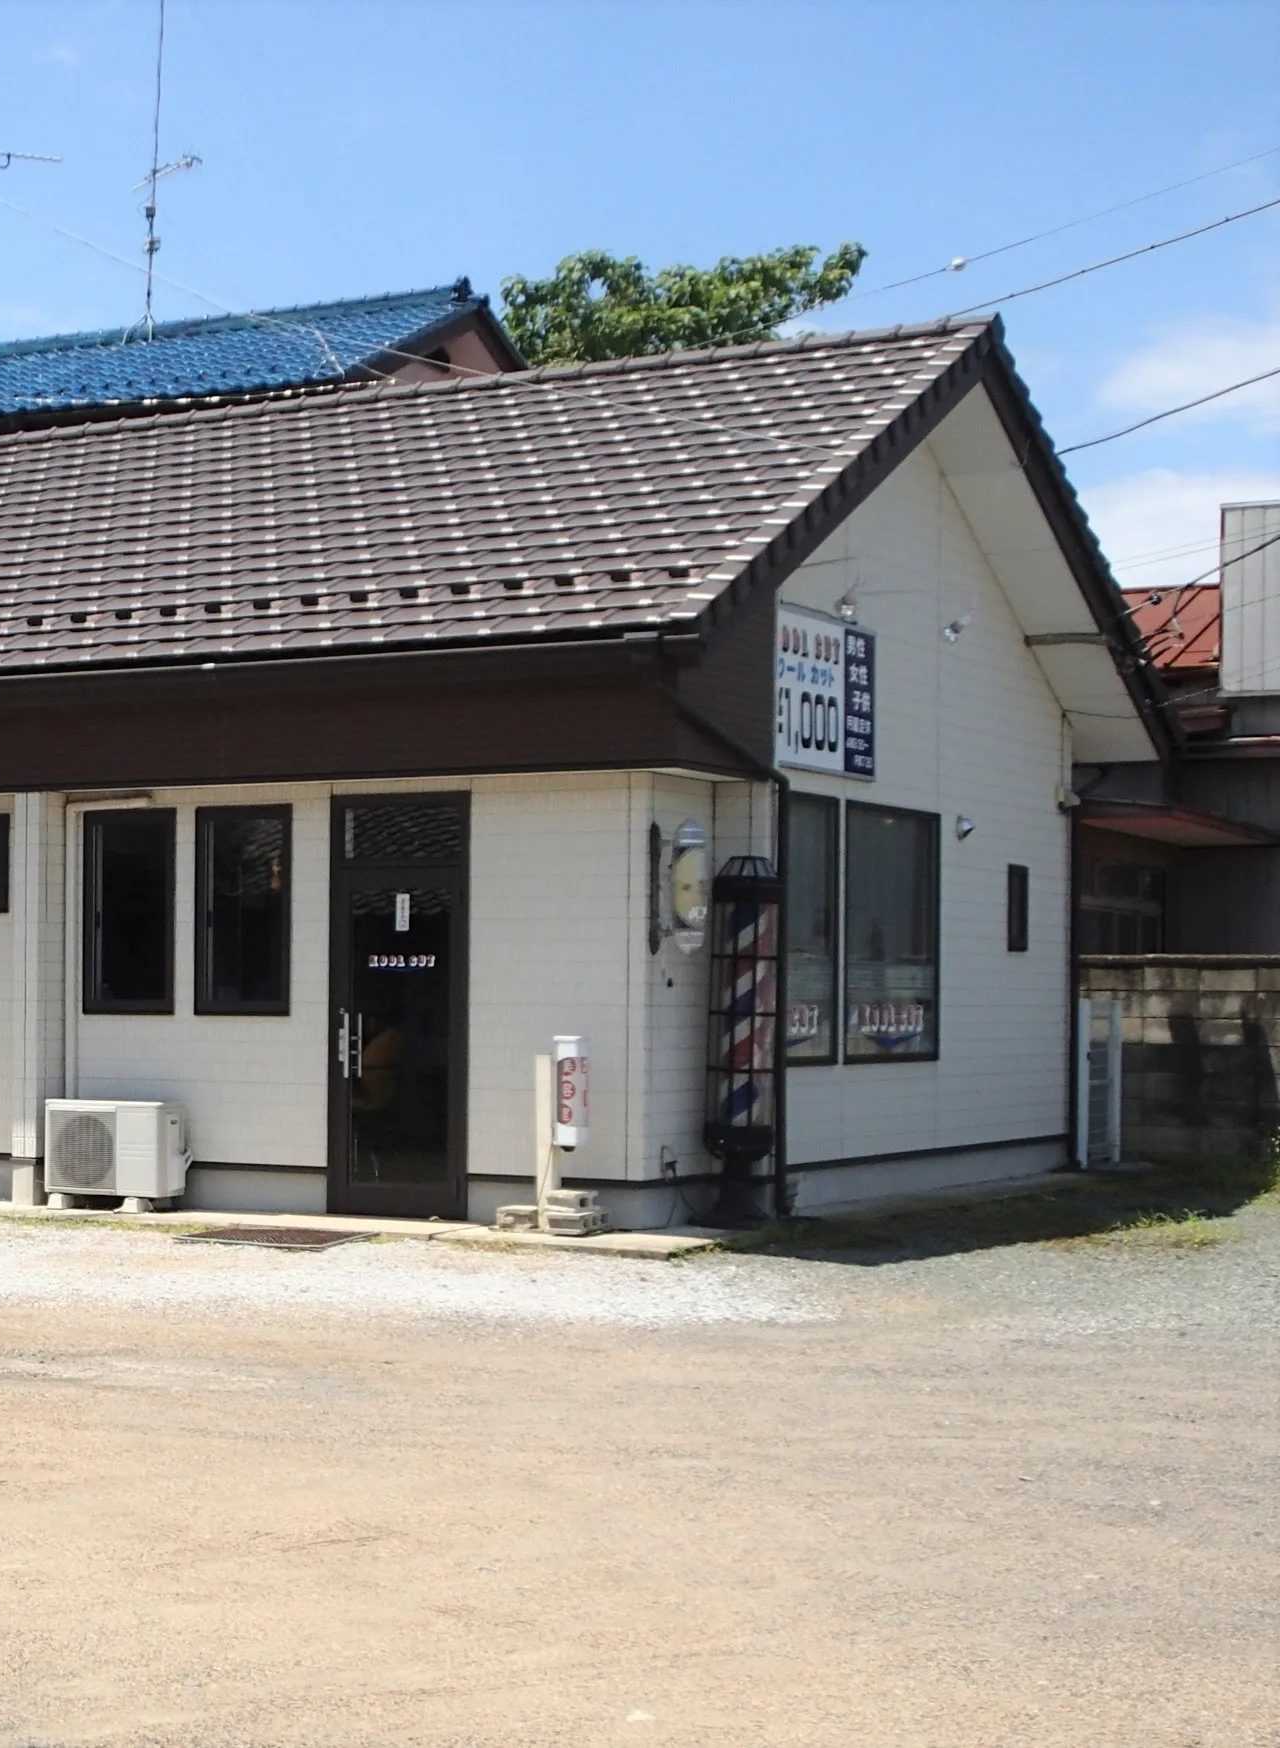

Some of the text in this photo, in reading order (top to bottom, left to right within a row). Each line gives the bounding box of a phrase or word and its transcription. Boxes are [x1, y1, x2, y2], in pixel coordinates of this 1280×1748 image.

[781, 624, 809, 657] OOL
[846, 635, 866, 658] 男性
[849, 663, 869, 686] 女性
[851, 690, 872, 713] 子供
[368, 954, 436, 967] KOOL CUT
